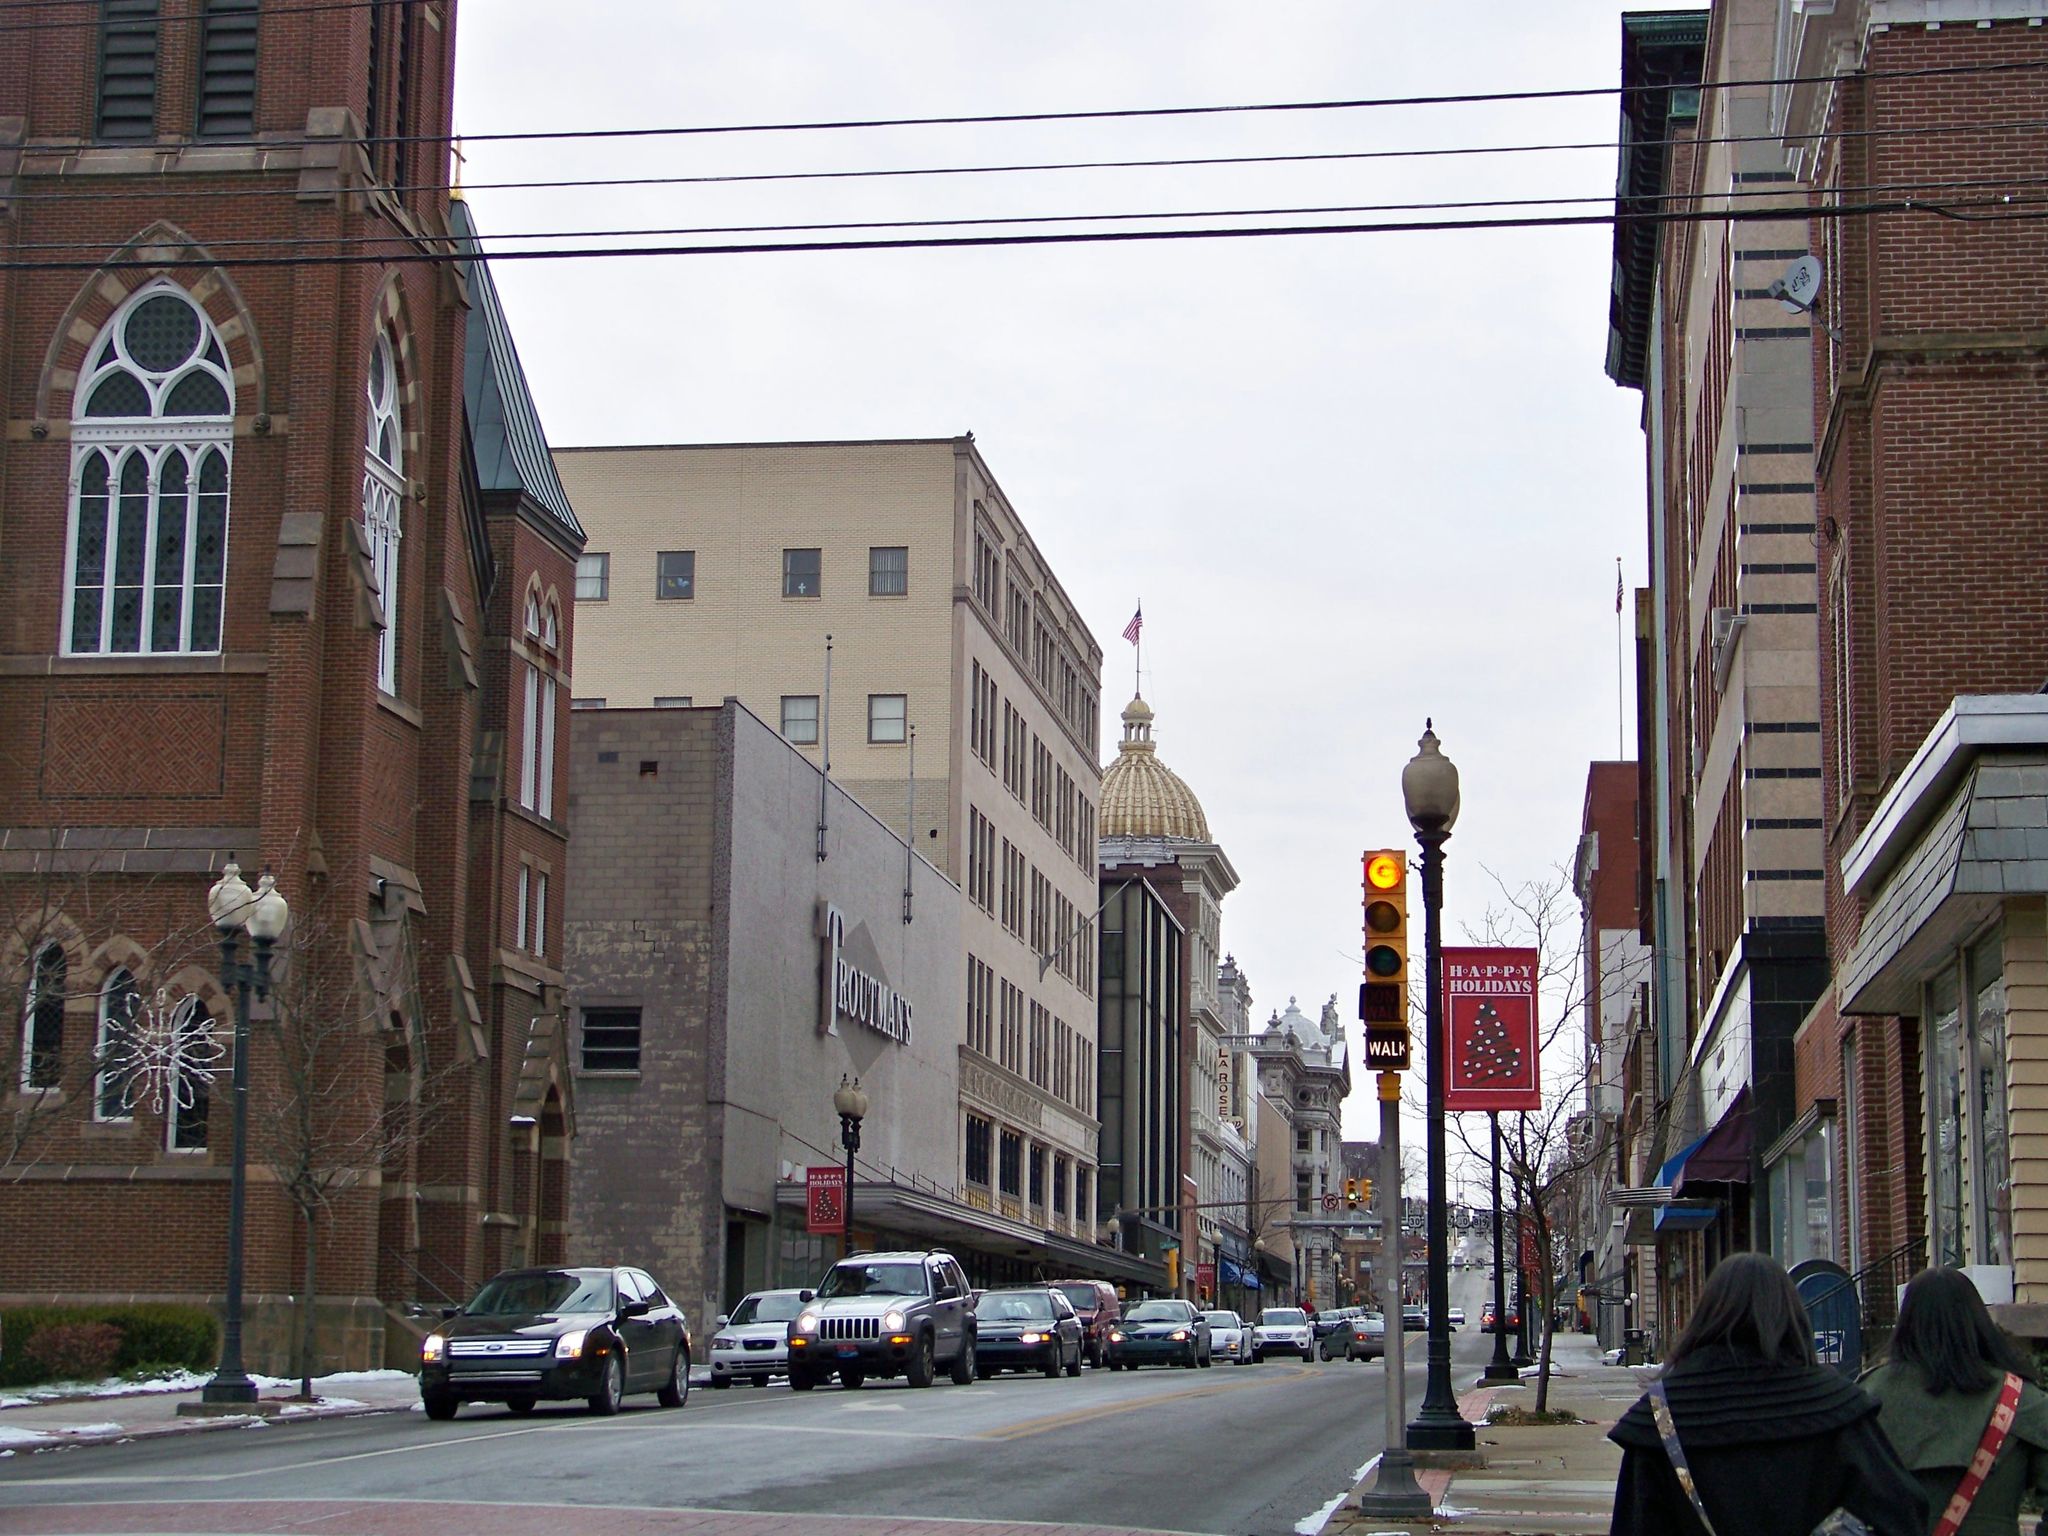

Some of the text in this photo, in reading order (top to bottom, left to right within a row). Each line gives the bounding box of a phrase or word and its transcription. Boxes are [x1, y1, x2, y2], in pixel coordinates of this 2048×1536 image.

[827, 901, 913, 1046] TROUTMAN'S
[1450, 980, 1533, 993] HOLIDAYS
[1369, 1041, 1406, 1057] WALK
[1218, 1048, 1229, 1116] LA ROSE
[1410, 1217, 1420, 1226] 30
